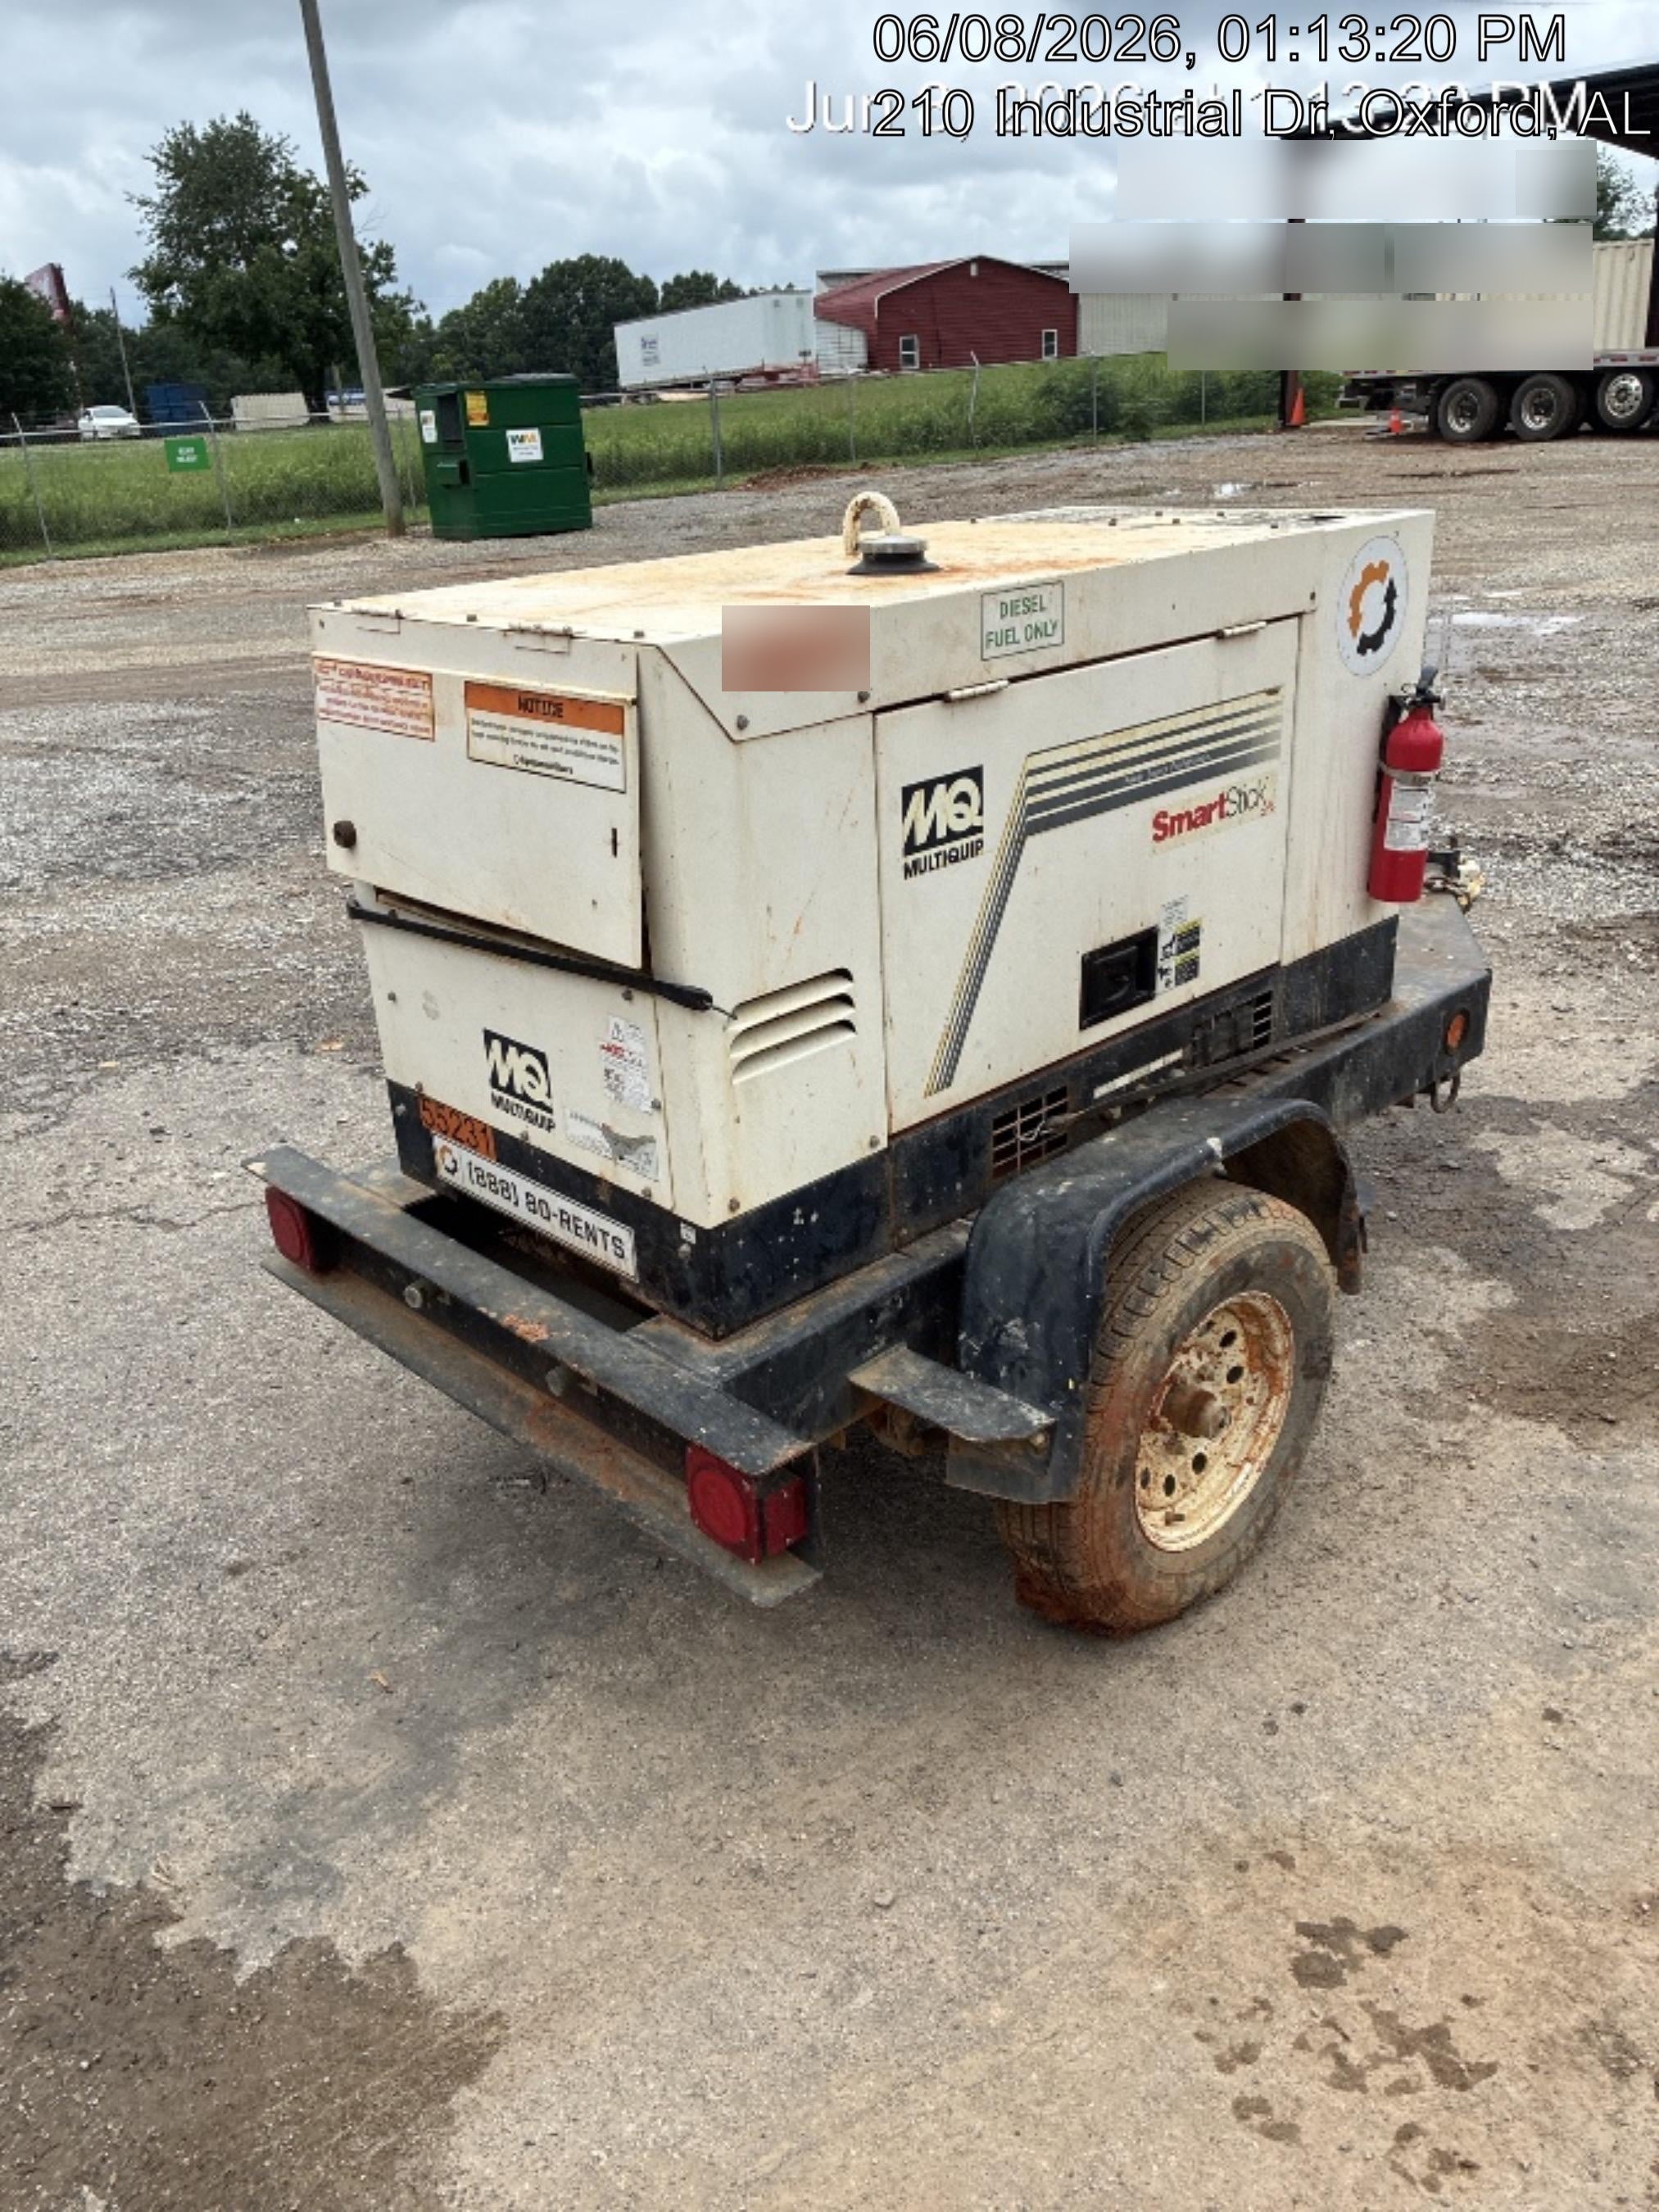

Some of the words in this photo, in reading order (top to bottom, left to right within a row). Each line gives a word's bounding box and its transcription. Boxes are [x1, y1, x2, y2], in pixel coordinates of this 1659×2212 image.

[1000, 594, 1048, 619] DIESEL
[986, 627, 1021, 650] FUEL
[1024, 619, 1058, 642] ONLY
[517, 695, 564, 718] NOTICE
[902, 776, 983, 847] MQ
[904, 838, 983, 881] MULTIQUIP
